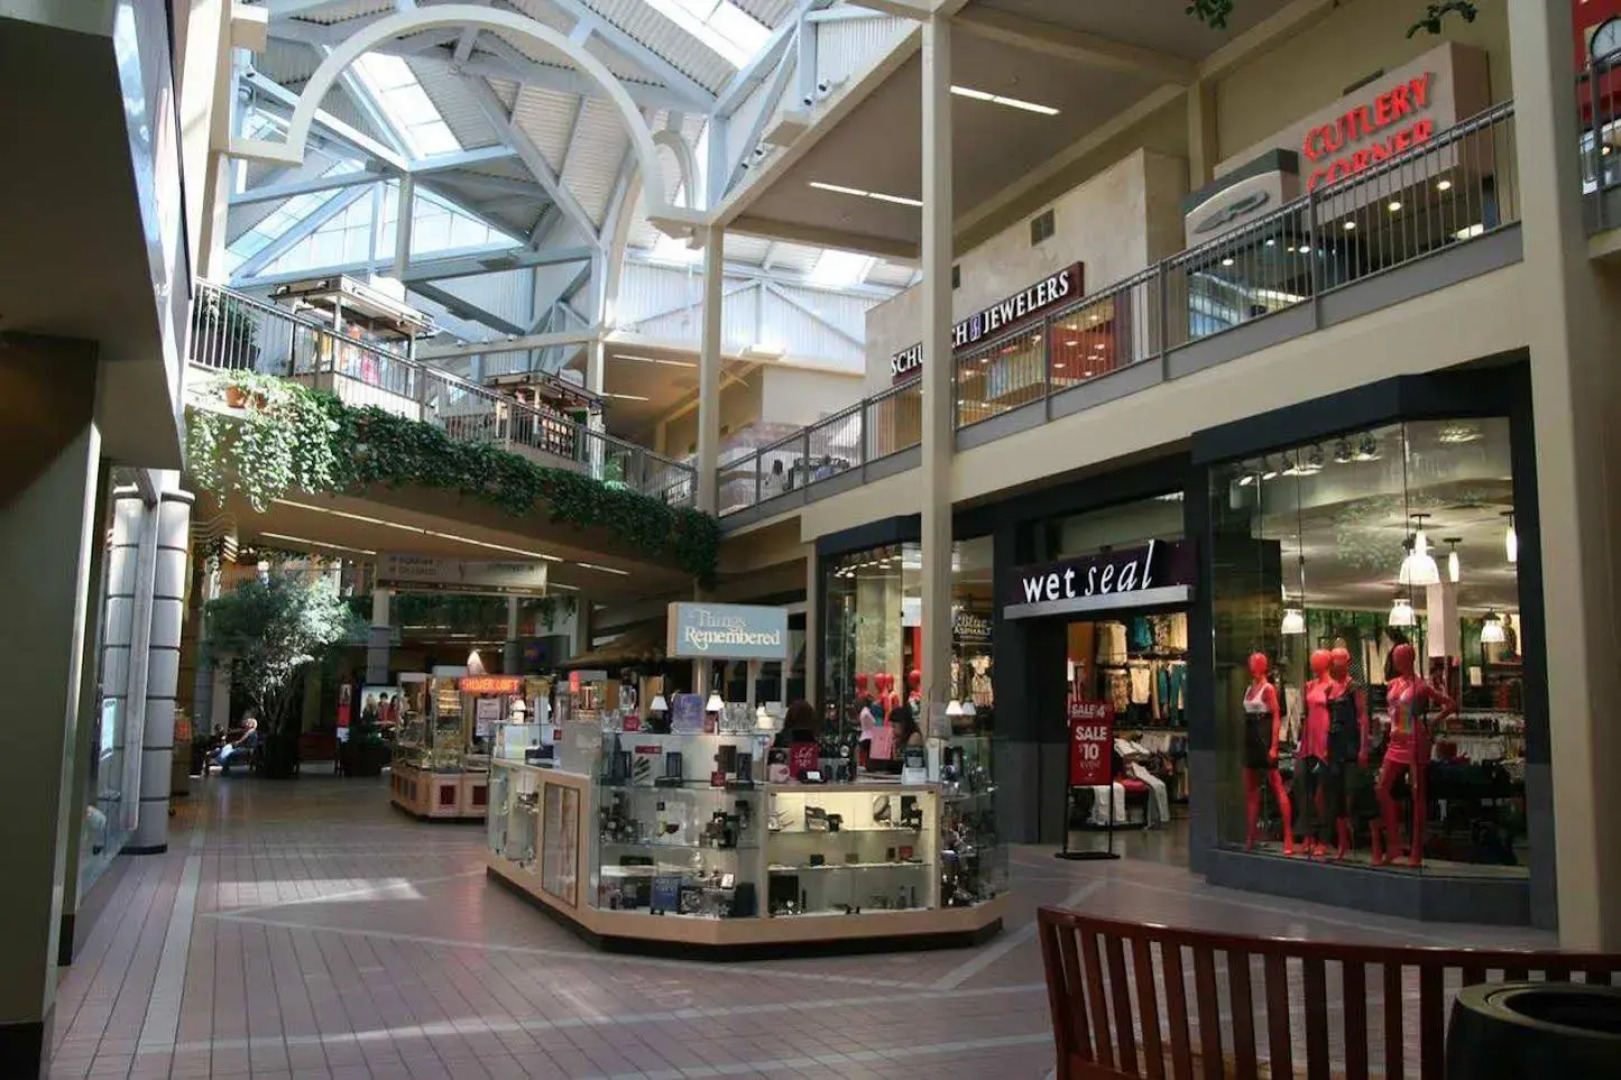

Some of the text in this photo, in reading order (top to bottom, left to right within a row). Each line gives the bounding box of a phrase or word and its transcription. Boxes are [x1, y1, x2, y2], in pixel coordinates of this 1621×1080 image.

[1303, 72, 1431, 162] CUTLERY
[983, 270, 1069, 335] JEWELERS
[1022, 538, 1155, 603] wet seal
[685, 626, 781, 651] Remembered
[688, 608, 746, 633] Things
[1075, 726, 1108, 741] SALE
